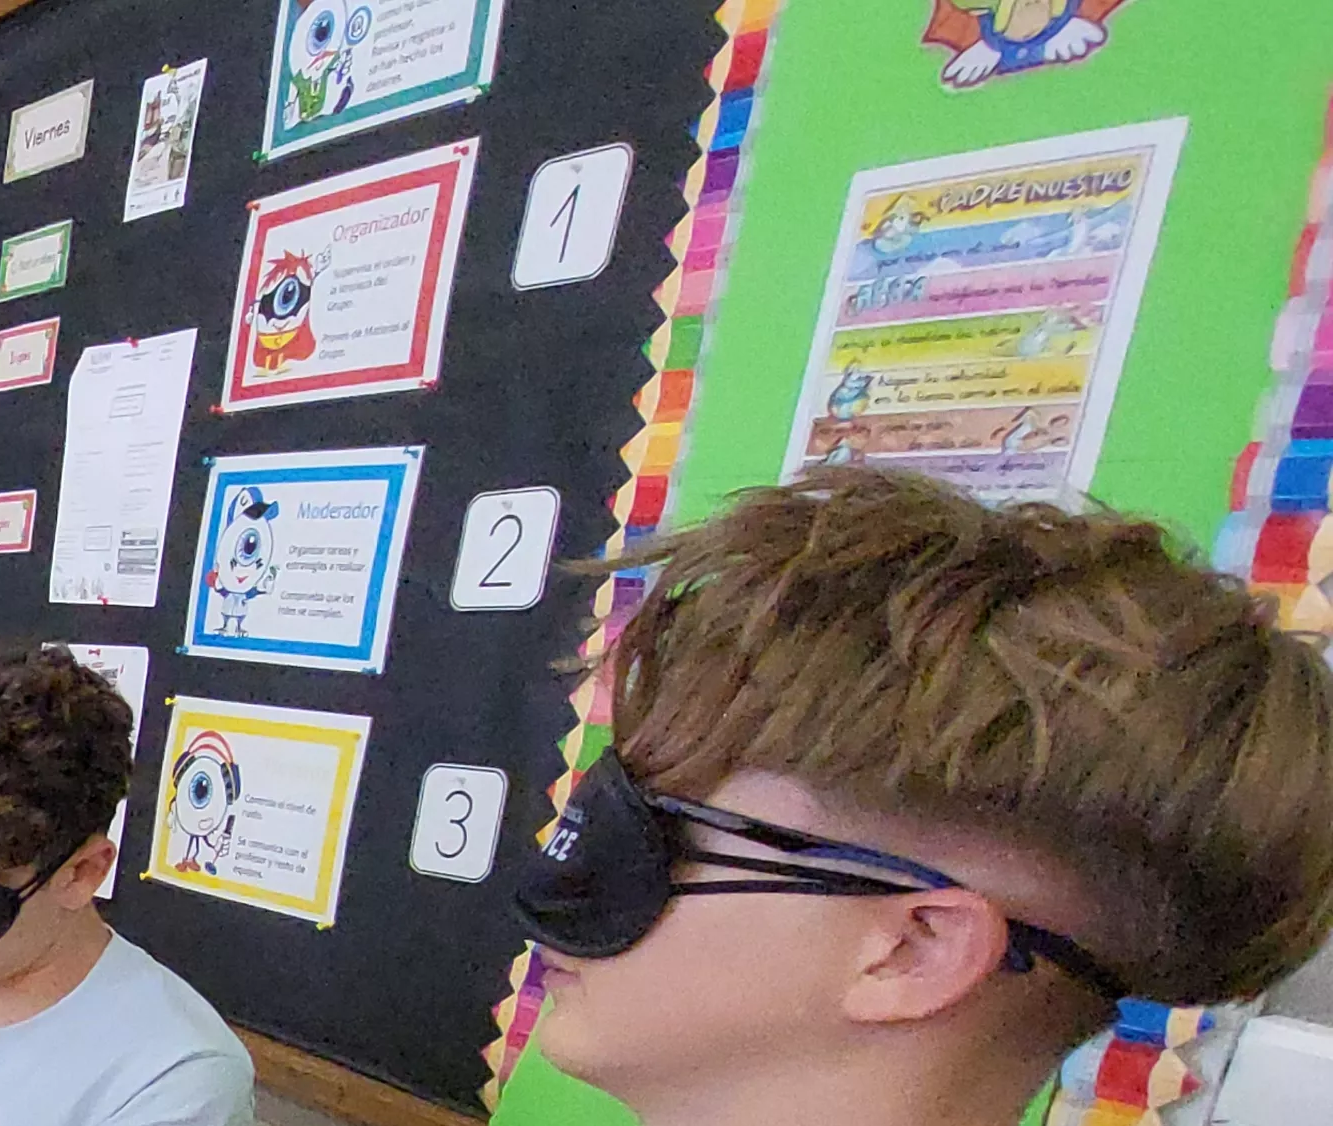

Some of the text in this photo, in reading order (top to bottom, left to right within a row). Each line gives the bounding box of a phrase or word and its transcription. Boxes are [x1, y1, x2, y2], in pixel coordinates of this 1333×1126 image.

[24, 119, 71, 150] Viernes
[938, 169, 1134, 213] PADRE NUESTRO
[333, 206, 431, 244] Organizador
[549, 184, 582, 264] 1
[297, 500, 381, 520] Moderador
[478, 513, 524, 589] 2
[435, 788, 473, 860] 3
